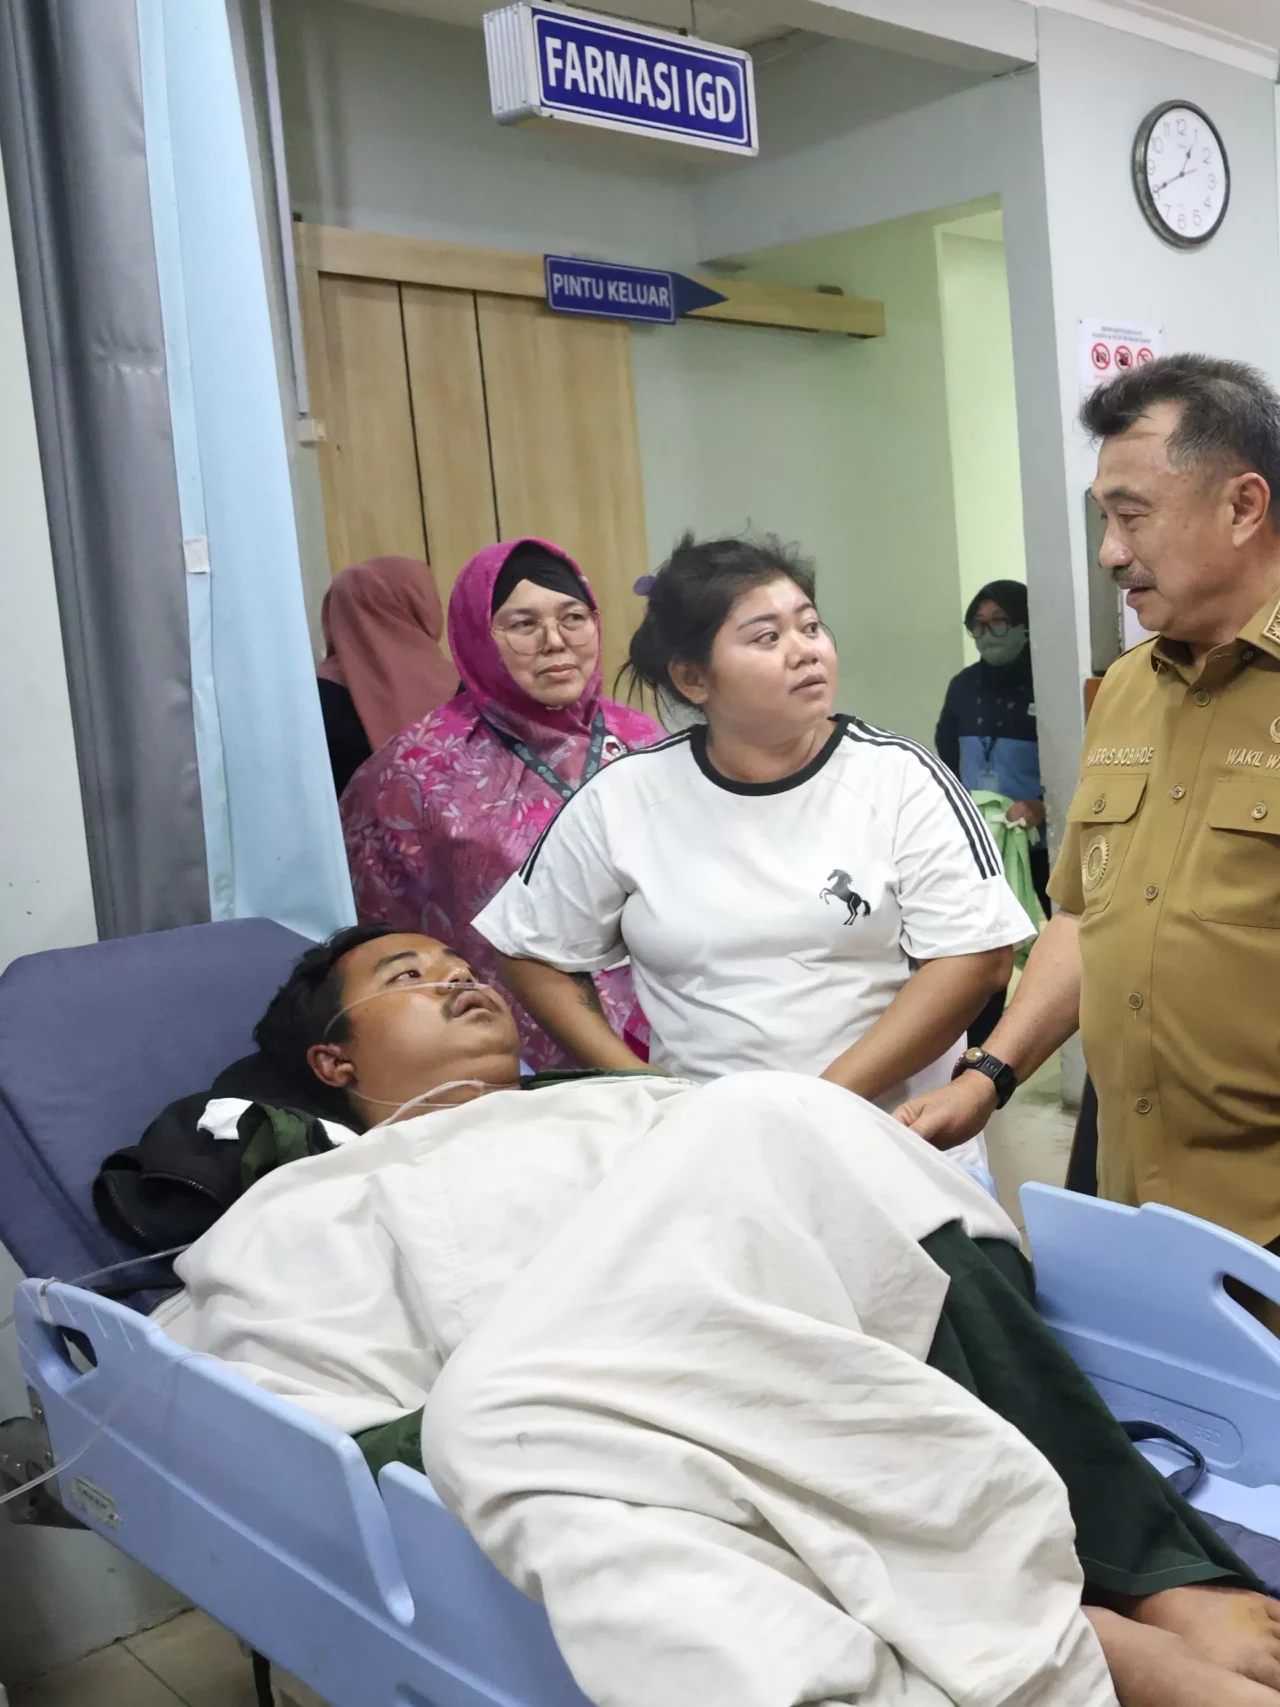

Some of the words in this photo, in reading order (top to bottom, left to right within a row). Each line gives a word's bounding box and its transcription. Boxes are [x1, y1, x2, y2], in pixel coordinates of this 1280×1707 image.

[545, 36, 681, 113] FARMASI
[685, 68, 737, 123] IGD
[1176, 118, 1188, 136] 12
[1202, 147, 1212, 165] 2
[1146, 159, 1156, 176] 9
[1207, 173, 1217, 190] 3
[1151, 184, 1161, 201] 8
[1177, 213, 1187, 231] 6
[1192, 209, 1201, 227] 5
[552, 272, 604, 300] PINTU
[606, 280, 670, 308] KELUAR
[1225, 748, 1264, 768] WAKIL
